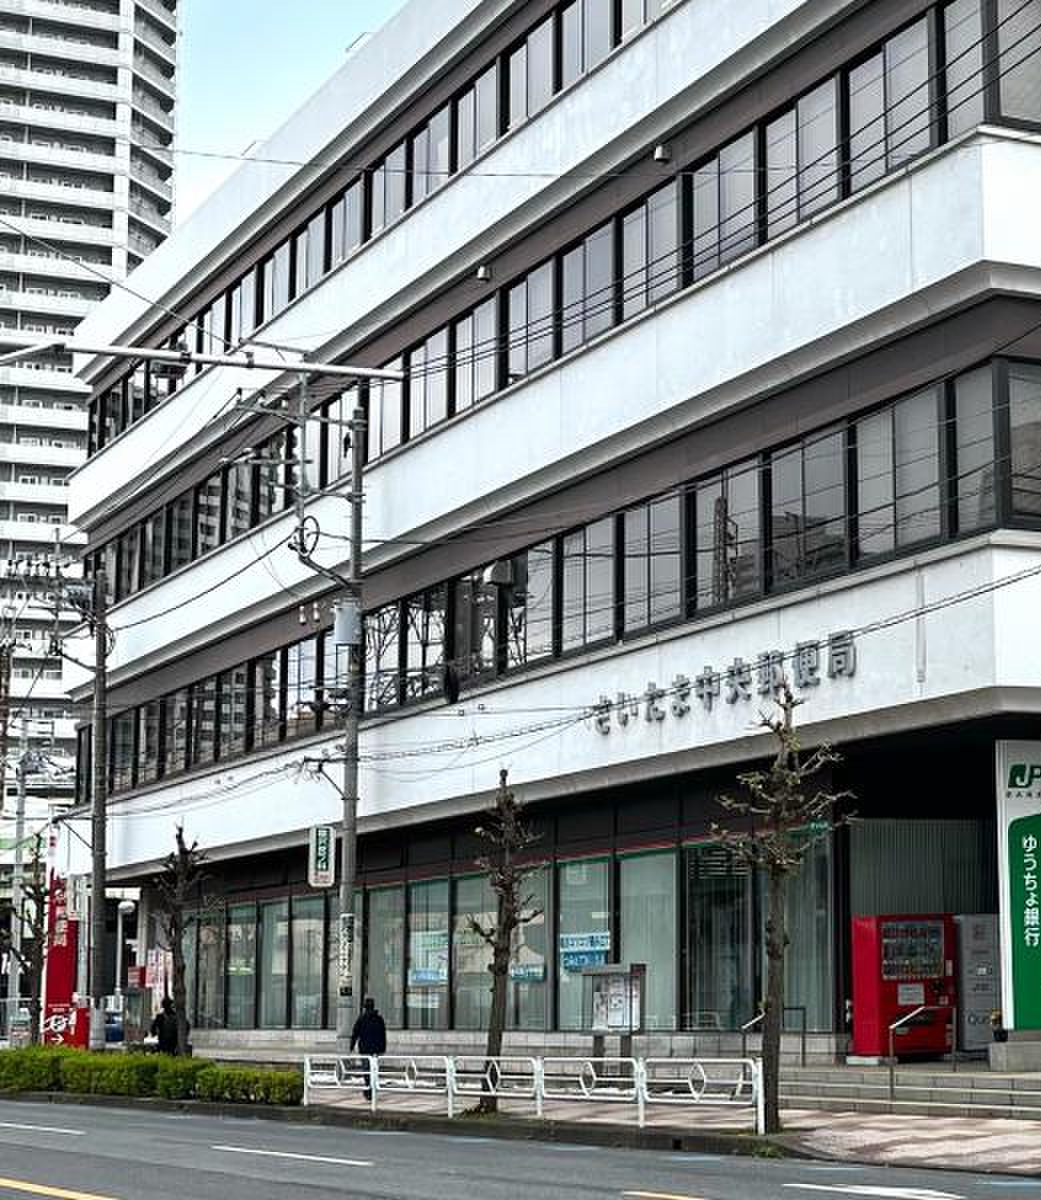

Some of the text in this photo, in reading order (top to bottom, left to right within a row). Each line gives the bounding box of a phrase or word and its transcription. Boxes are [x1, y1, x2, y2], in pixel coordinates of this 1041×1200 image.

[1022, 834, 1041, 948] ゆうちょ銀行
